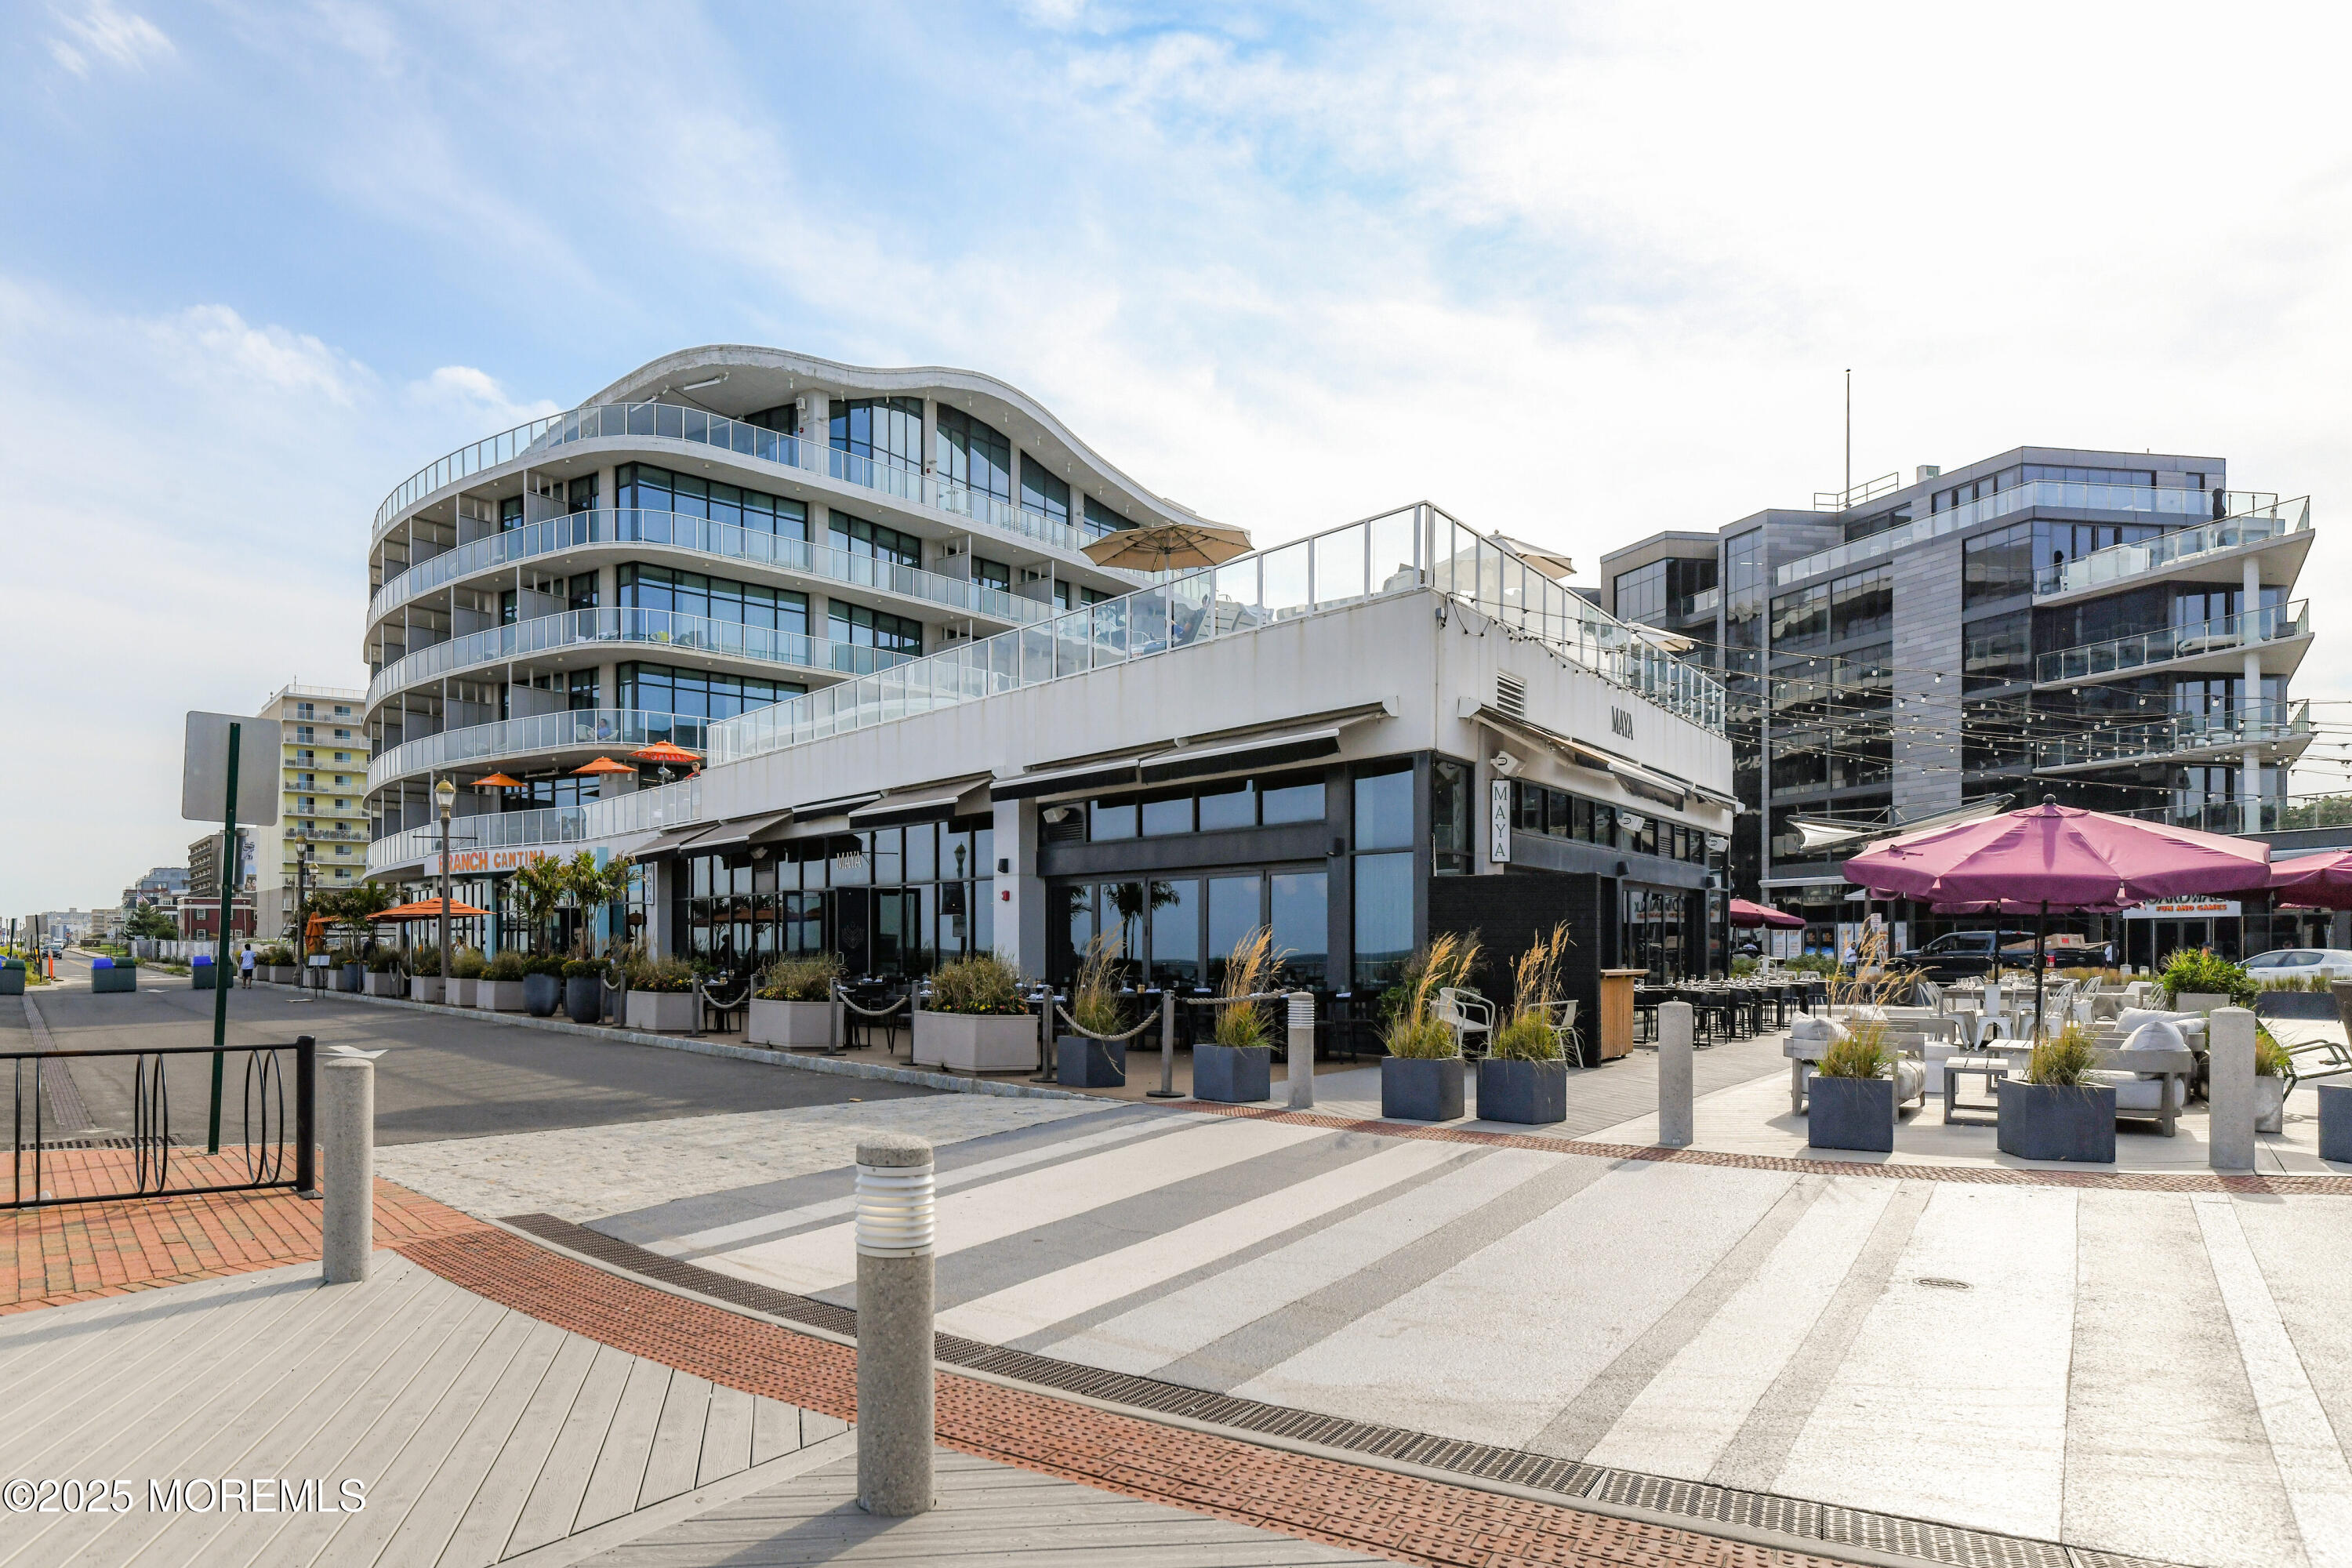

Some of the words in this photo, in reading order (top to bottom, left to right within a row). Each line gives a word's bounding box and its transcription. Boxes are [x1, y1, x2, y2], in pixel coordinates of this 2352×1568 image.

[1611, 705, 1633, 740] MAYA
[1494, 786, 1508, 857] MAYA
[836, 851, 862, 870] MAYA
